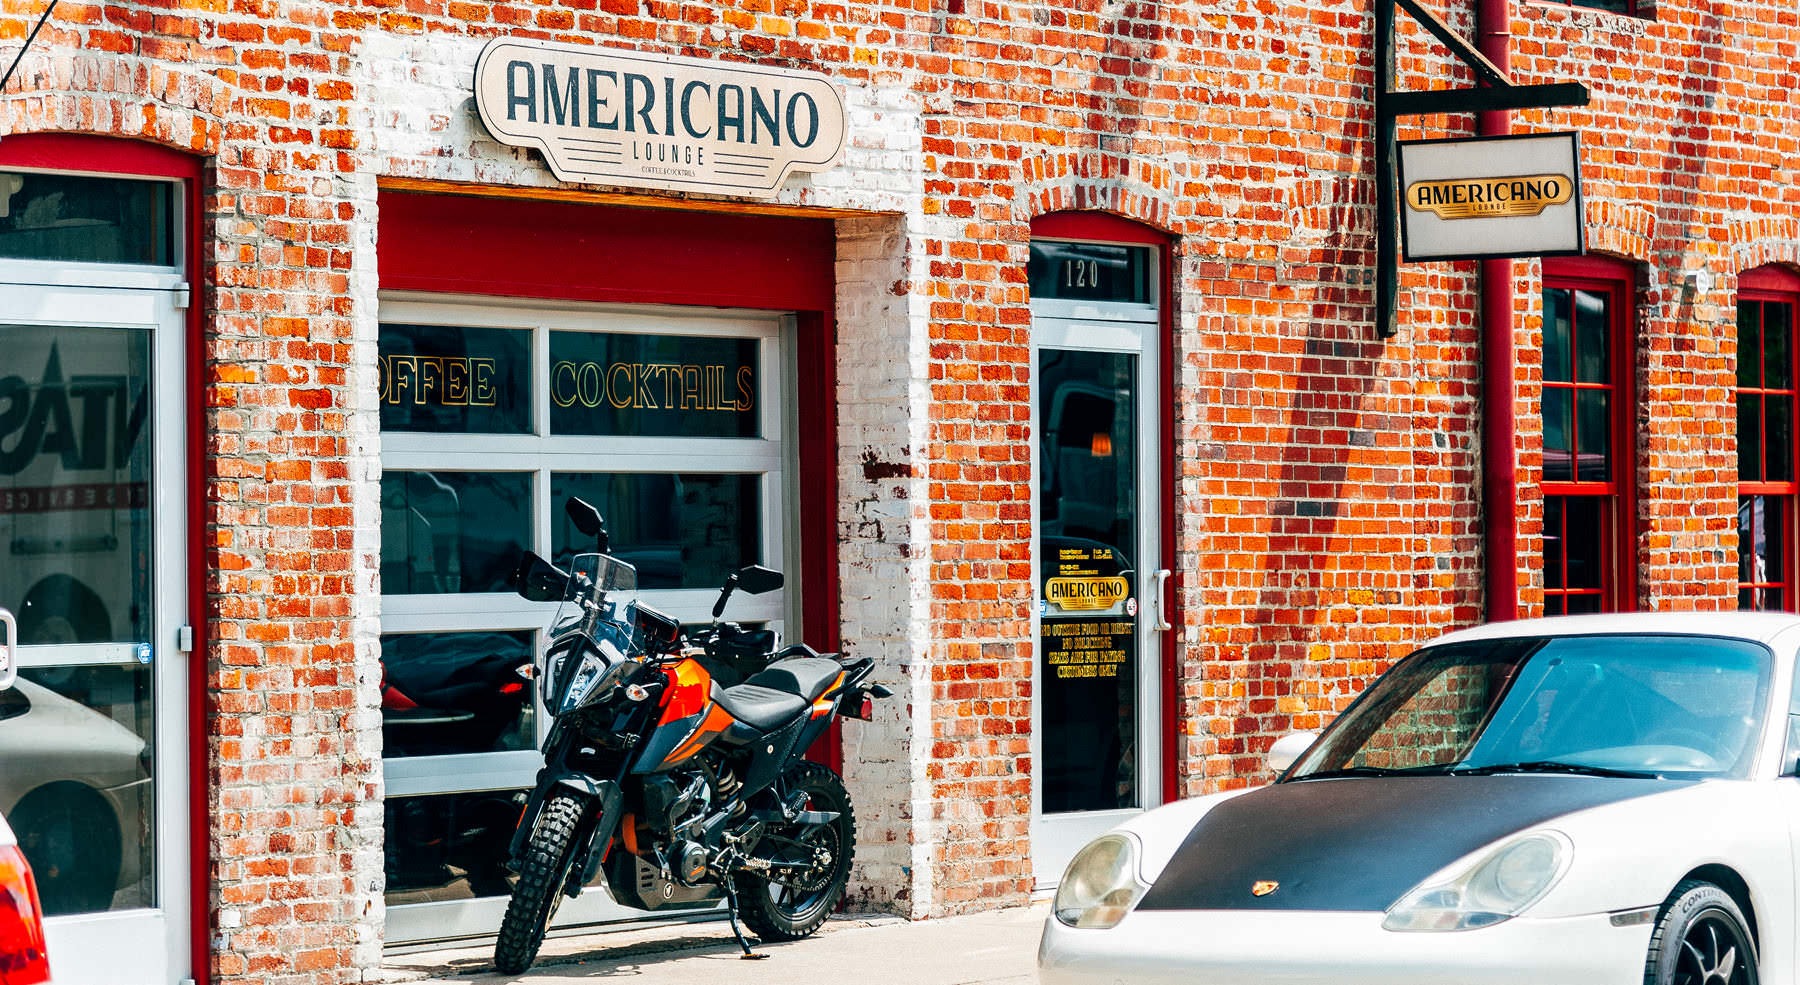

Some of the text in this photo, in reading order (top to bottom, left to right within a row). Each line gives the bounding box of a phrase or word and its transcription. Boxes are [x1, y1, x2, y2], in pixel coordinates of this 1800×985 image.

[506, 59, 820, 149] AMERICANO
[633, 140, 704, 166] LOUNGE
[1417, 180, 1560, 206] AMERICANO
[1066, 259, 1098, 288] 120
[550, 360, 754, 412] COCKTAILS
[1051, 582, 1122, 598] AMERICANO
[1062, 637, 1073, 650] NO
[1070, 651, 1084, 664] ARE
[1085, 651, 1098, 663] FOR
